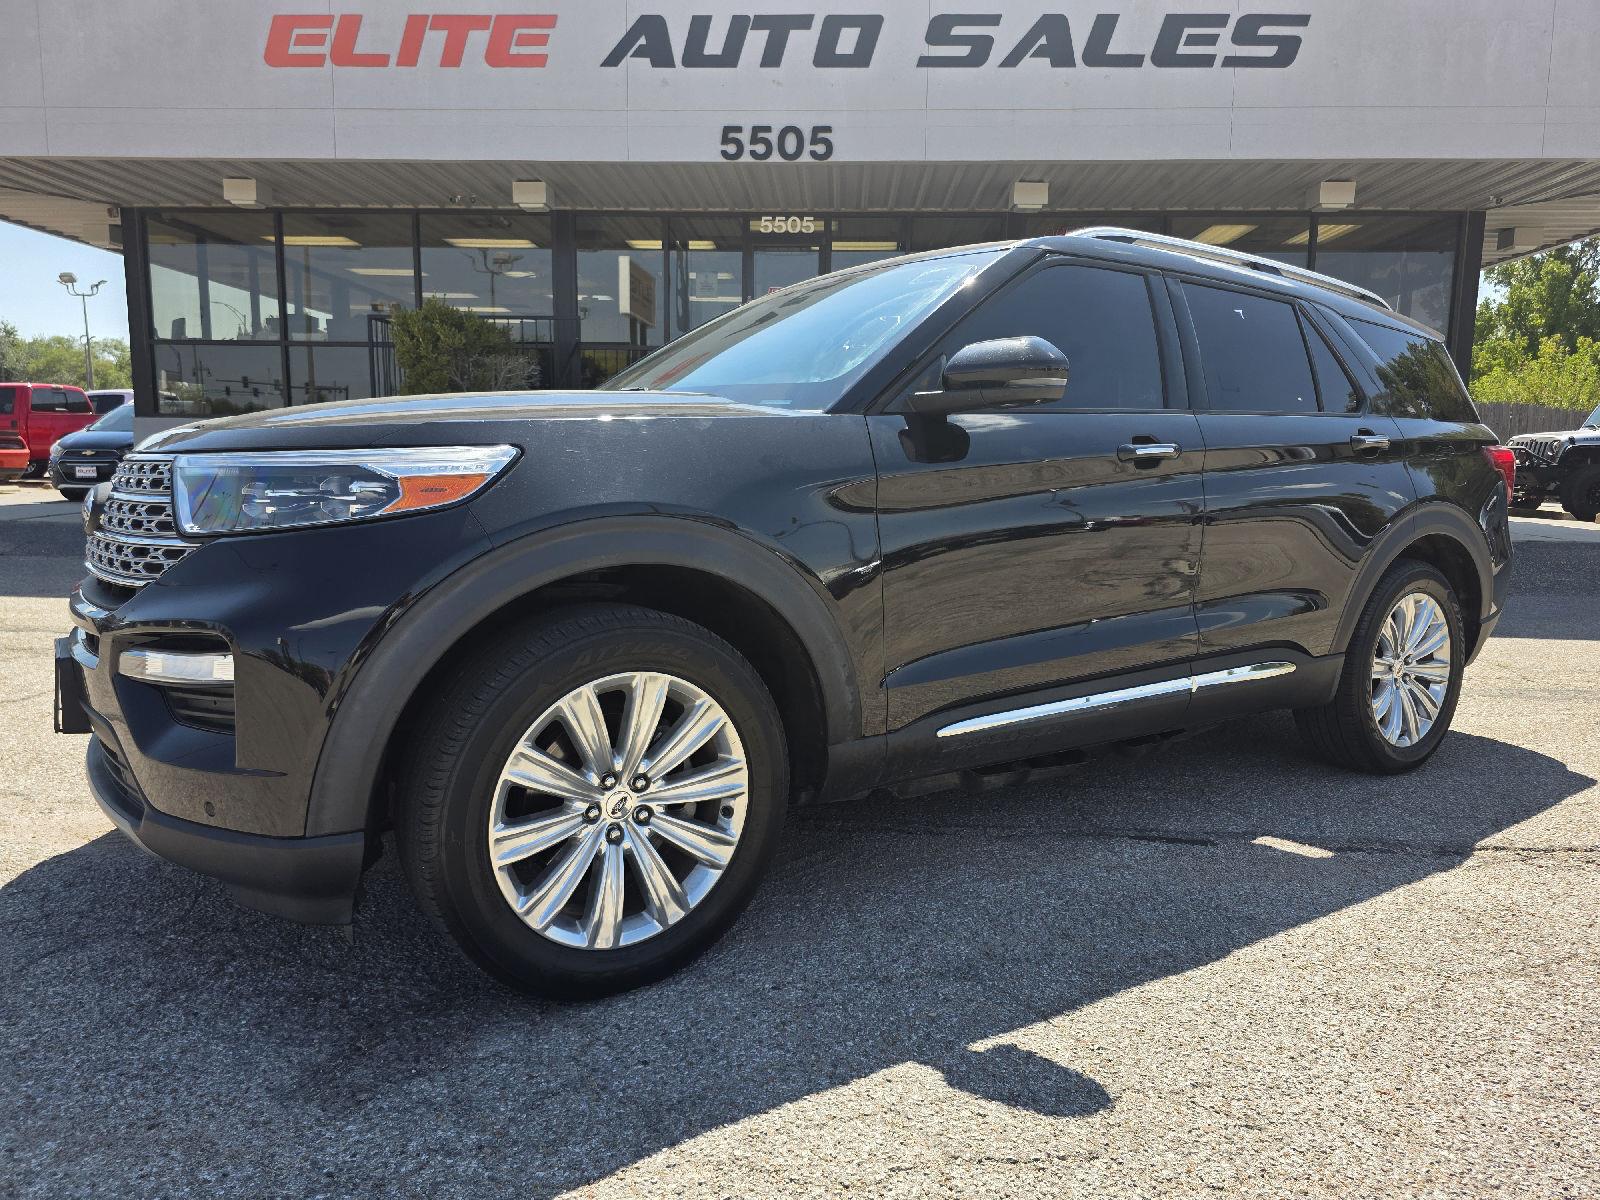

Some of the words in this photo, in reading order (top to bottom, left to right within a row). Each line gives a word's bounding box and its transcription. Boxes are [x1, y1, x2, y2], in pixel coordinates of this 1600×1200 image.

[264, 14, 557, 68] ELITE
[601, 14, 884, 68] AUTO
[917, 14, 1310, 68] SALES
[720, 125, 834, 161] 5505
[760, 216, 815, 233] 5505
